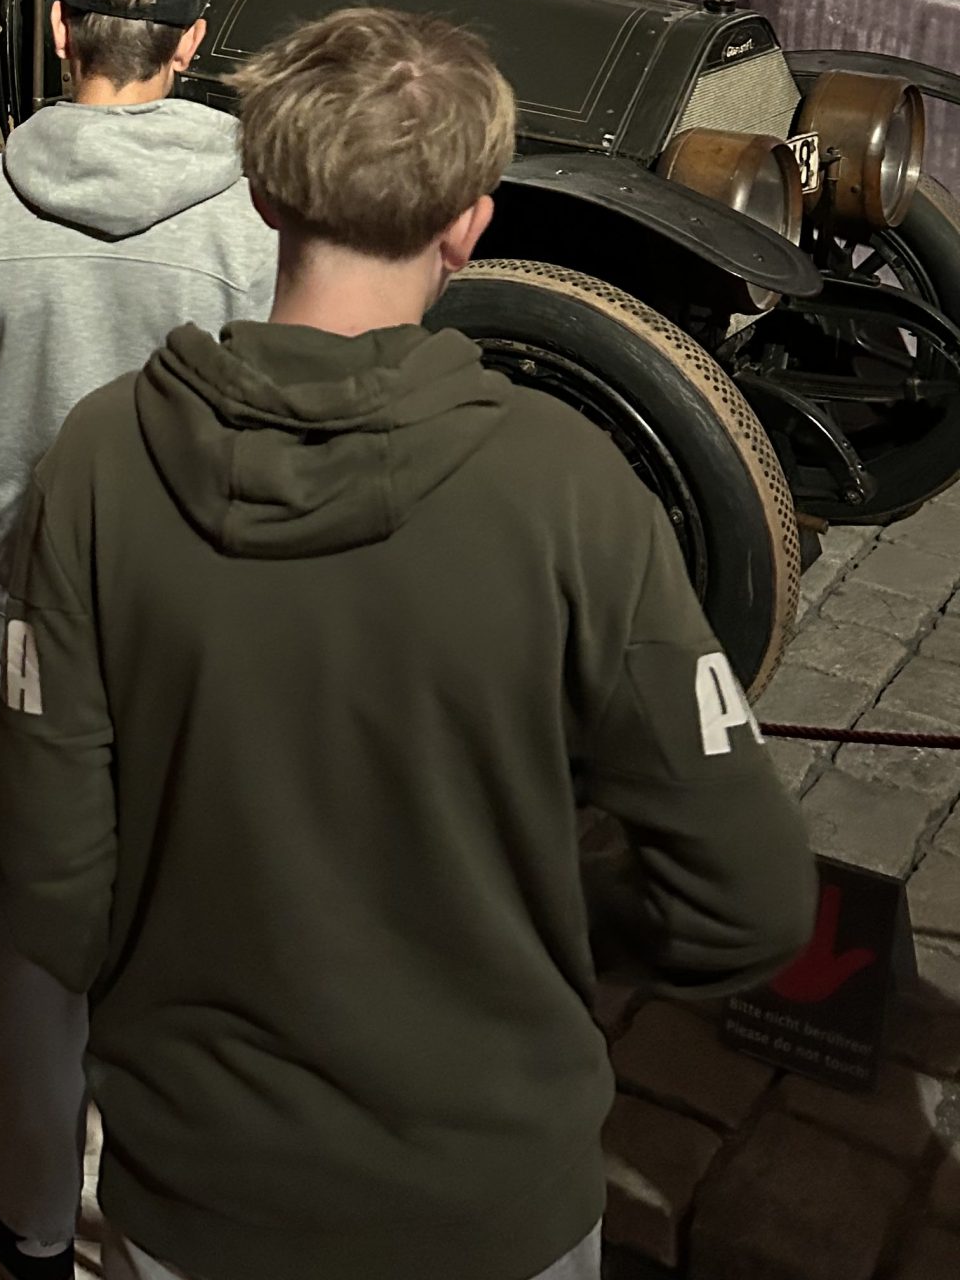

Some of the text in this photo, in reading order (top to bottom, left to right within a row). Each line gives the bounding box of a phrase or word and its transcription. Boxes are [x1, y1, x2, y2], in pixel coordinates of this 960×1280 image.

[6, 619, 43, 715] A
[695, 652, 766, 755] A
[726, 1018, 769, 1044] Please
[773, 1036, 792, 1052] do
[795, 1046, 820, 1063] not
[728, 996, 762, 1019] Bitte
[764, 1010, 800, 1032] nicht
